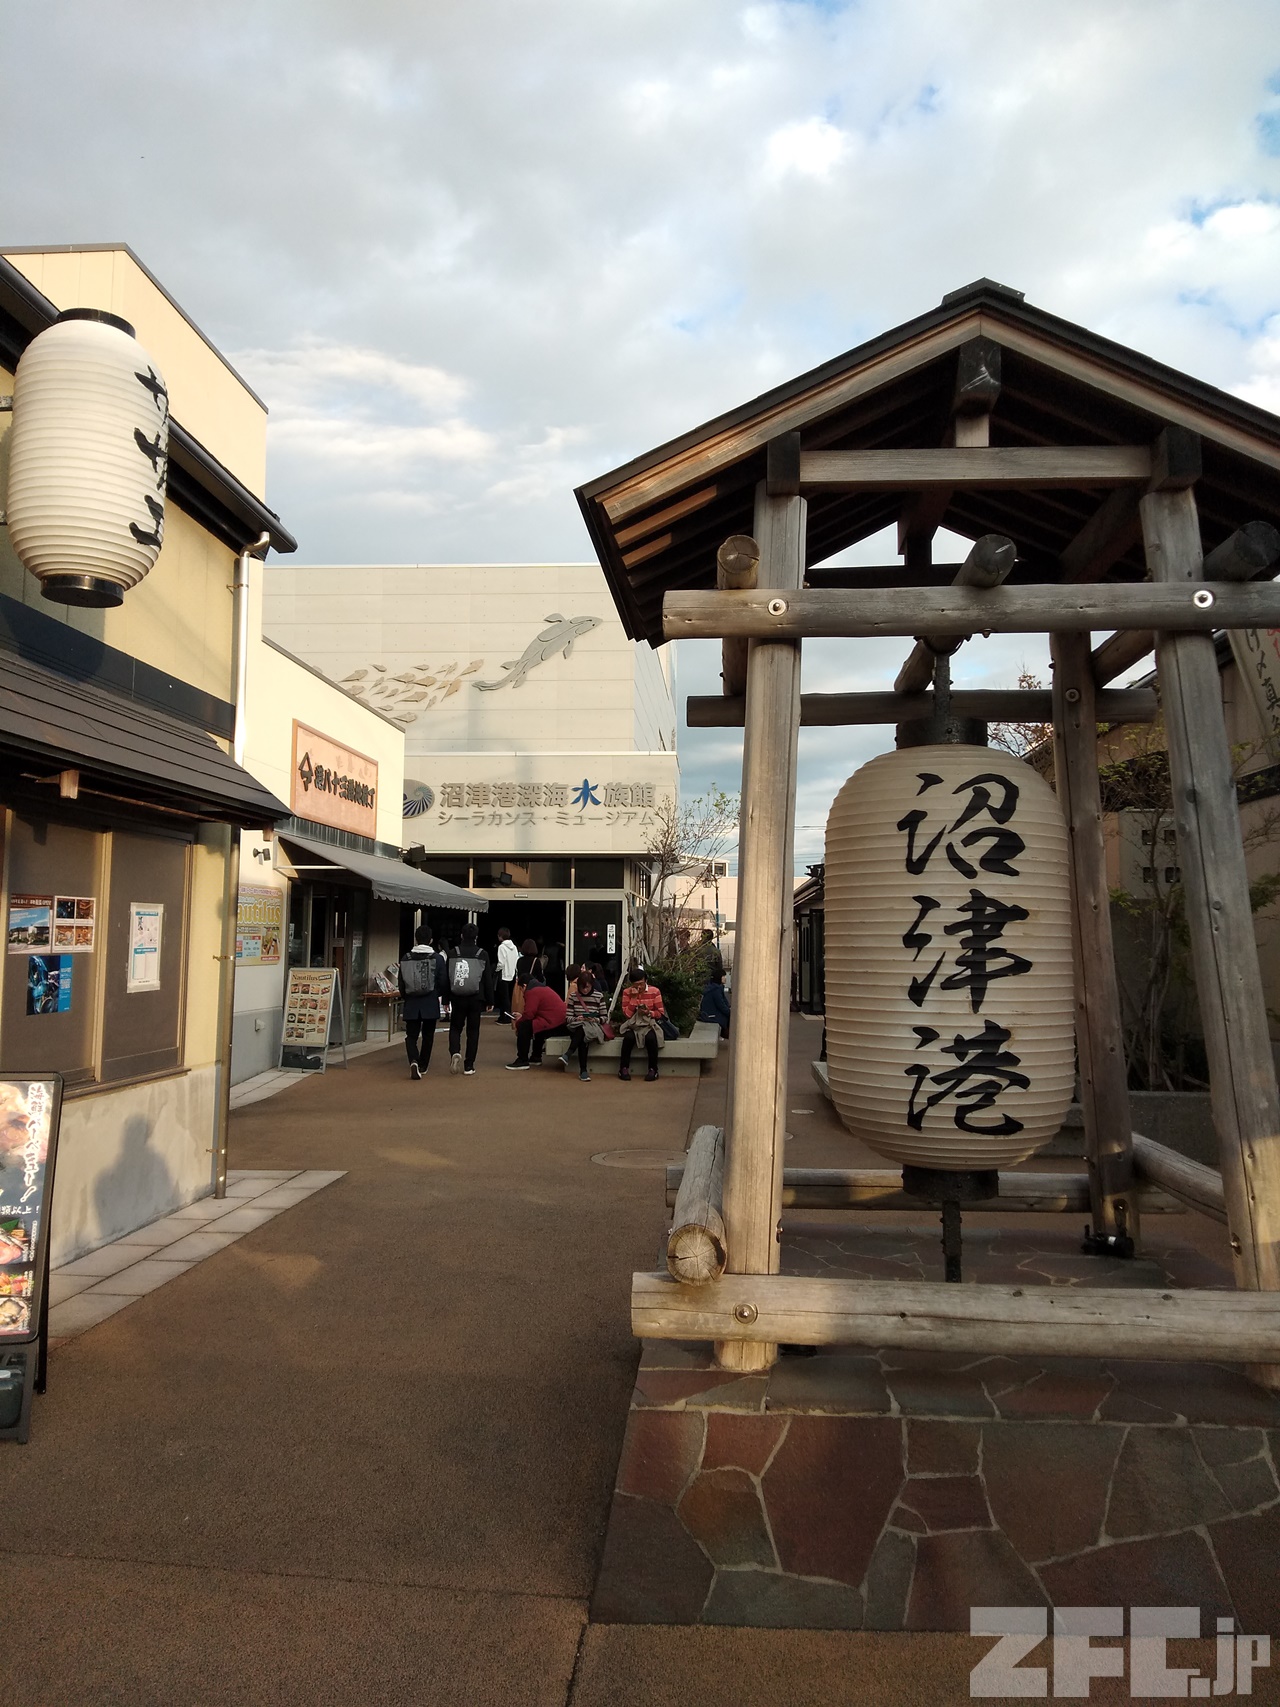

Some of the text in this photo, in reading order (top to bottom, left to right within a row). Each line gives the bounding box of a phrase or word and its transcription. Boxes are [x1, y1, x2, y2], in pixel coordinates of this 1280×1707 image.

[440, 778, 656, 812] 沼津港深海水族館
[438, 811, 655, 826] シーラカンス・ミュージアム
[896, 772, 1034, 1136] 沼津港
